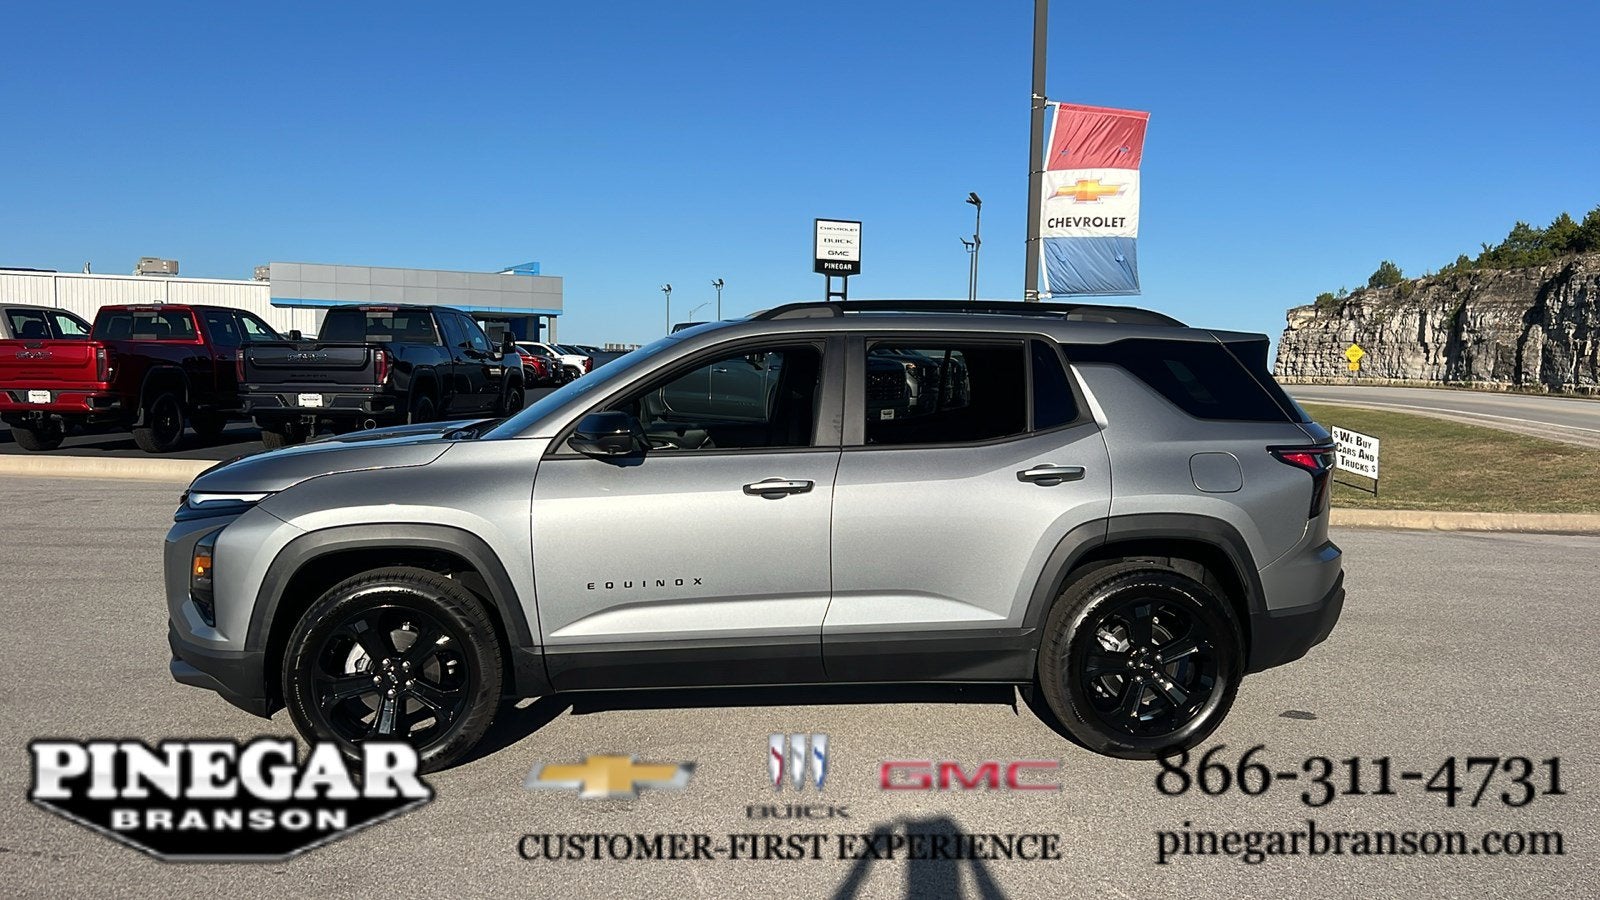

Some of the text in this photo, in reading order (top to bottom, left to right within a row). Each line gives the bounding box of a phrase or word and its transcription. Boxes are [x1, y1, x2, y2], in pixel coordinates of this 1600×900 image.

[1047, 216, 1126, 229] CHEVROLET
[824, 262, 852, 270] PINEGAR
[587, 578, 702, 590] EQUINOX
